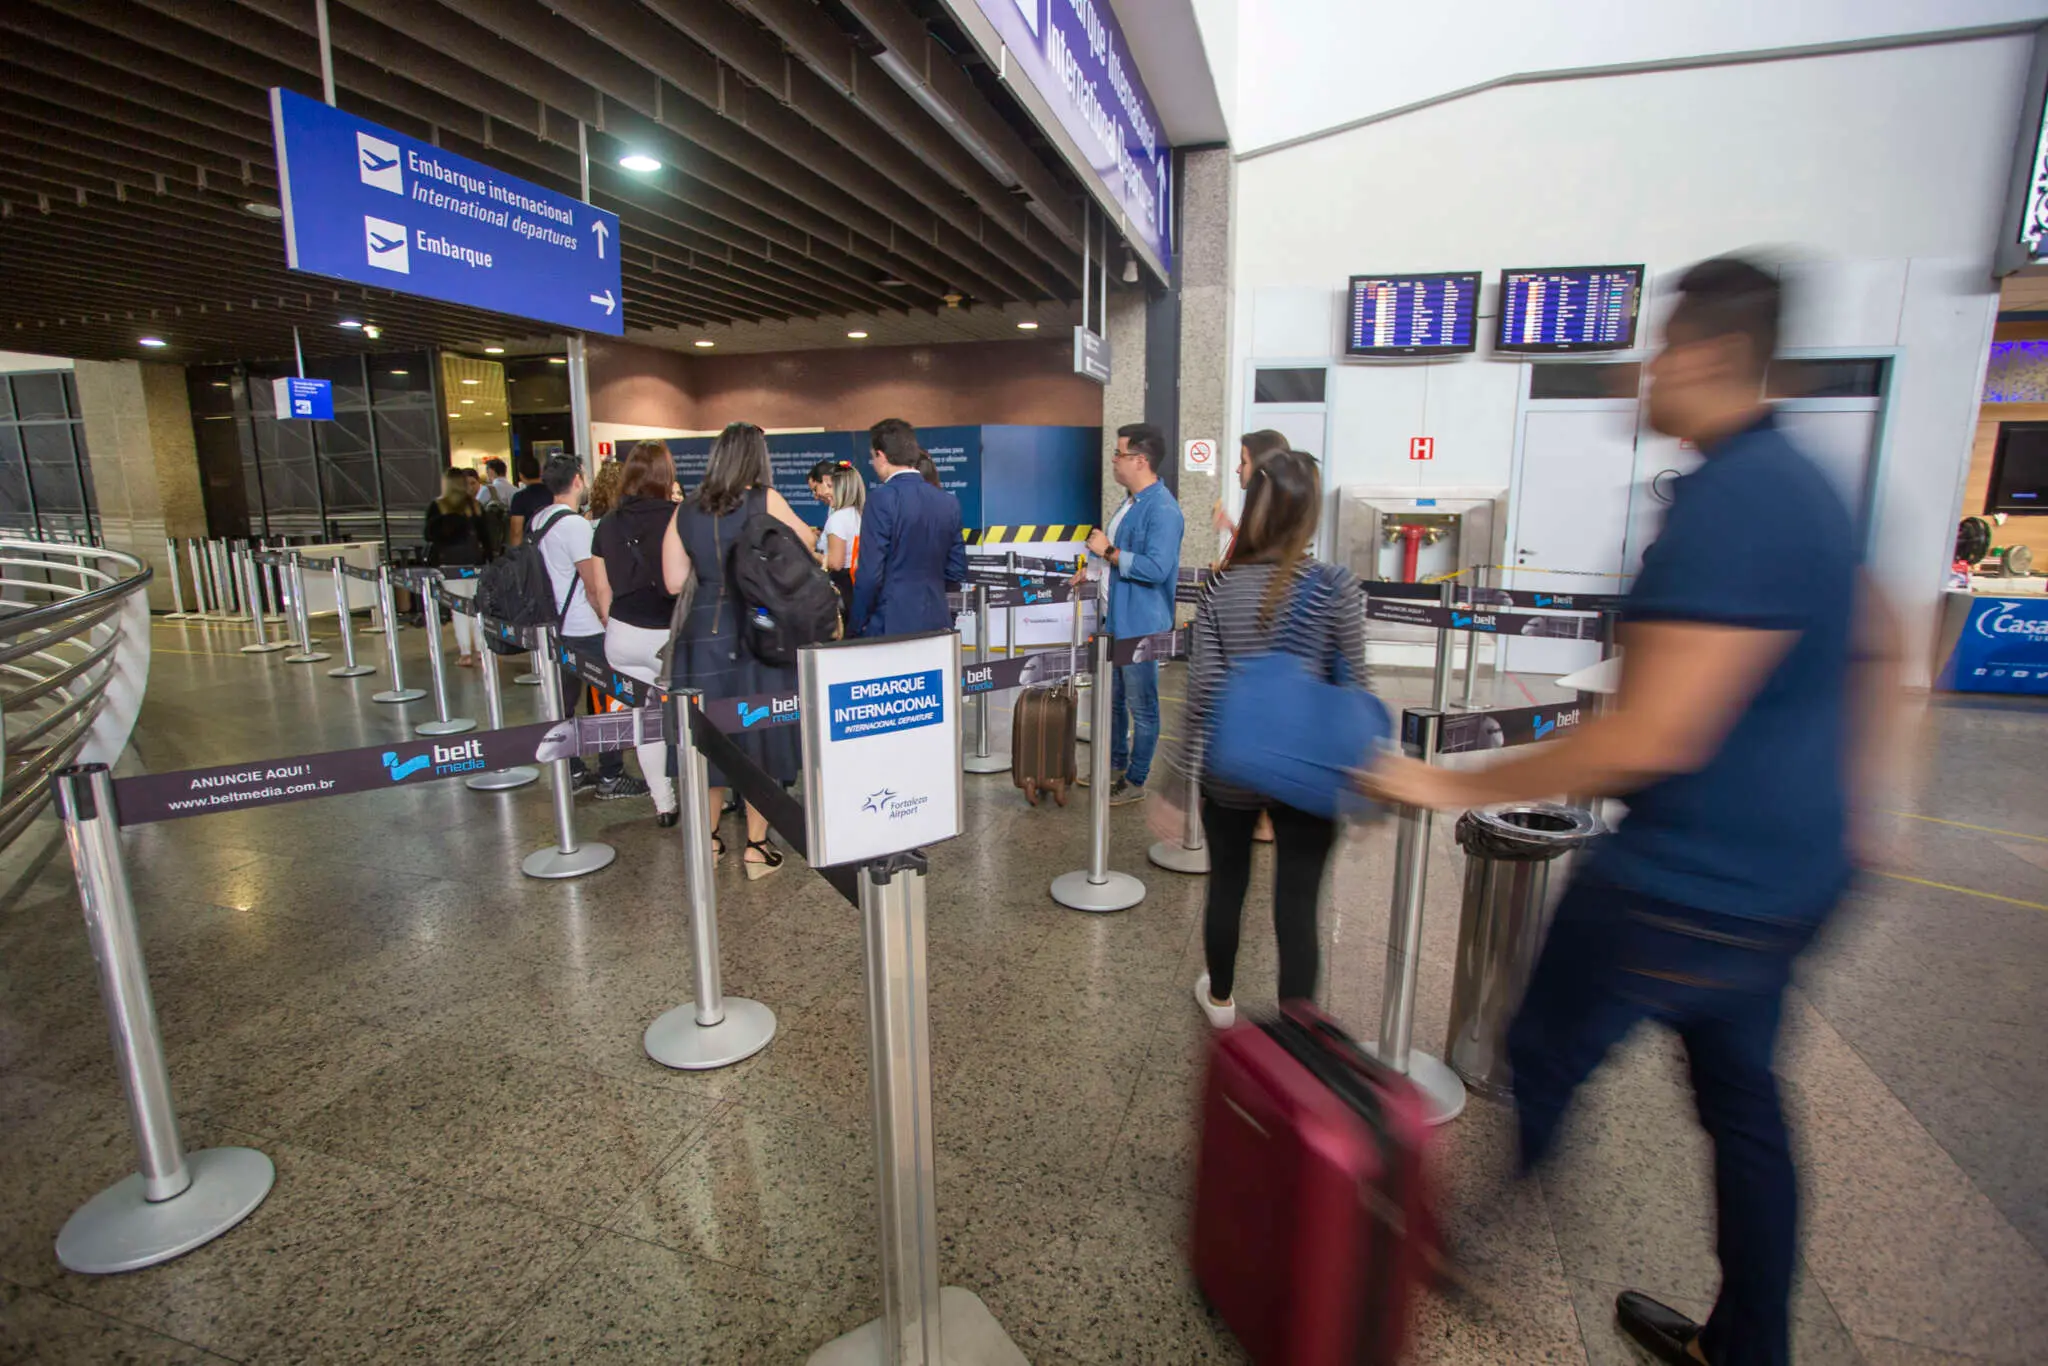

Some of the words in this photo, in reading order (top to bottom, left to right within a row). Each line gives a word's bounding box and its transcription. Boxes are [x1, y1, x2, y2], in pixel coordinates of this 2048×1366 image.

[1067, 0, 1106, 66] arque
[408, 150, 486, 196] Embarque
[489, 181, 574, 227] internacional
[412, 180, 508, 229] International
[511, 214, 578, 251] departures
[416, 230, 493, 268] Embarque
[1472, 613, 1497, 626] belt
[967, 667, 992, 684] belt
[851, 676, 926, 700] EMBARQUE
[772, 695, 800, 713] bel
[835, 694, 940, 723] INTERNACIONAL
[1556, 709, 1580, 727] belt
[434, 740, 484, 763] belt
[190, 770, 263, 790] ANUNCIE
[265, 765, 303, 780] AQUI
[305, 763, 312, 775] !
[435, 757, 486, 776] media
[168, 779, 336, 810] www.beltmedia.com.br
[889, 806, 918, 821] Airport
